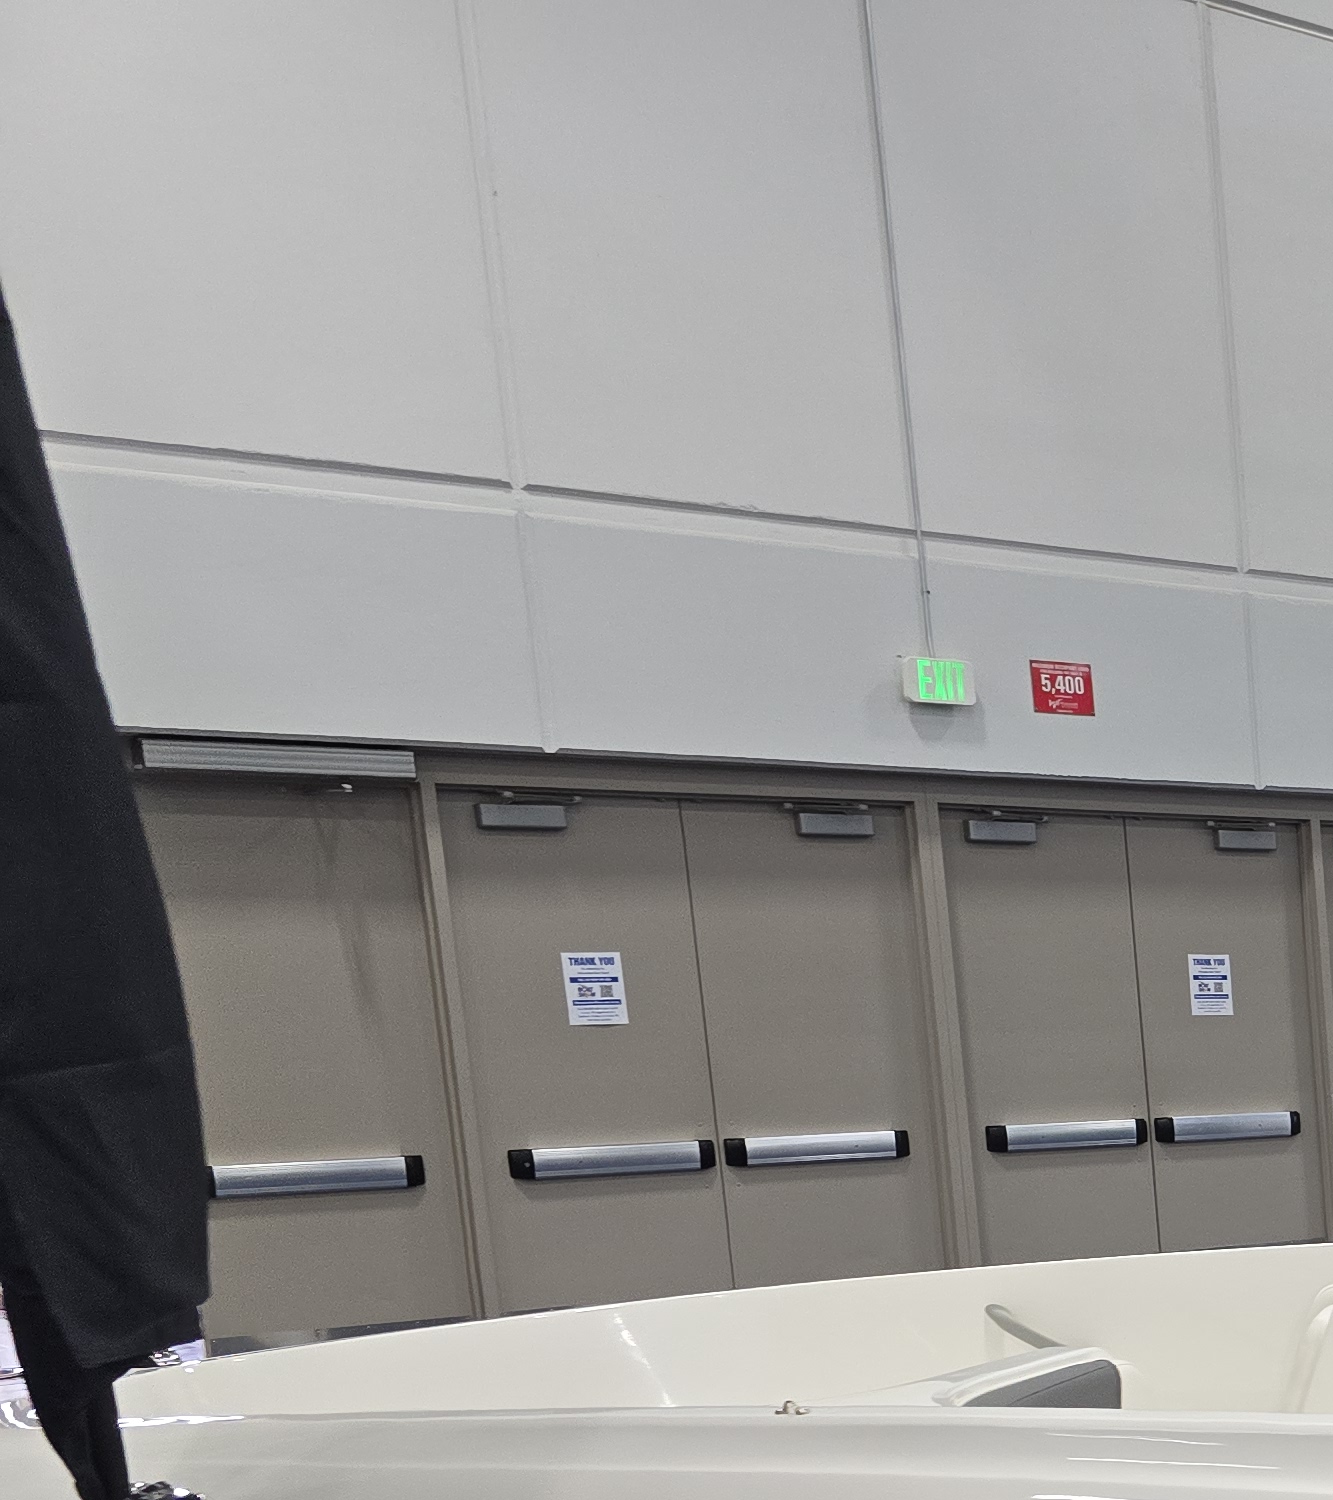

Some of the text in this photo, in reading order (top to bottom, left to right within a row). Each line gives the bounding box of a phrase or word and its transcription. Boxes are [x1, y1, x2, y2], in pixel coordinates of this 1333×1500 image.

[917, 659, 966, 701] EXIT
[1040, 673, 1085, 695] 5,400
[568, 957, 615, 966] THANK YOU
[1192, 958, 1226, 966] THANK YOU
